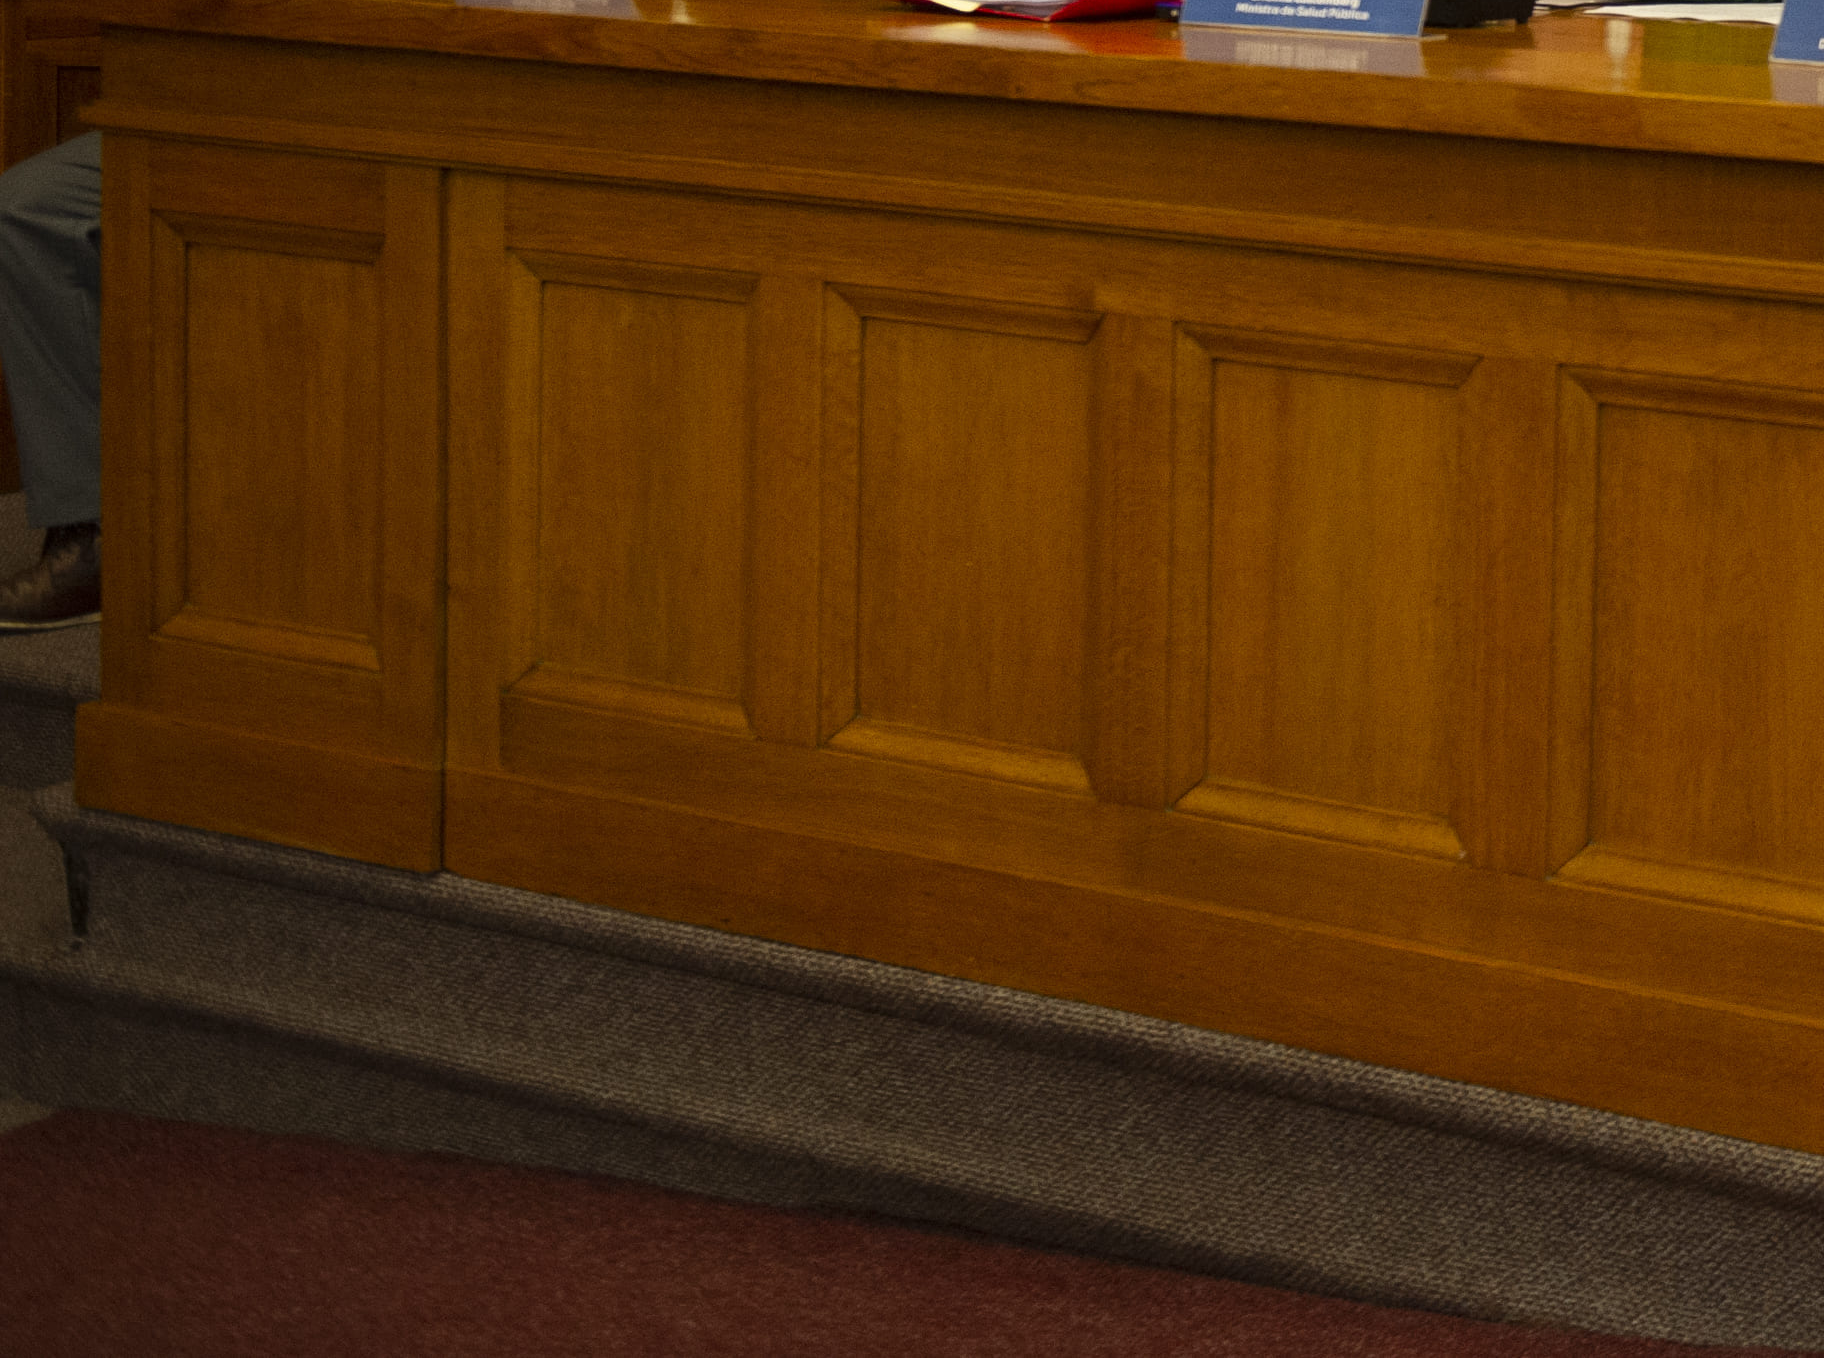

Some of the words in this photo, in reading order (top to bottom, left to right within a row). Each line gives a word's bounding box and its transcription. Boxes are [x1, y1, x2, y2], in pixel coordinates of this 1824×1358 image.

[1235, 2, 1279, 15] Ministra
[1280, 5, 1295, 15] de
[1296, 6, 1328, 19] Salud
[1328, 7, 1370, 21] Pública
